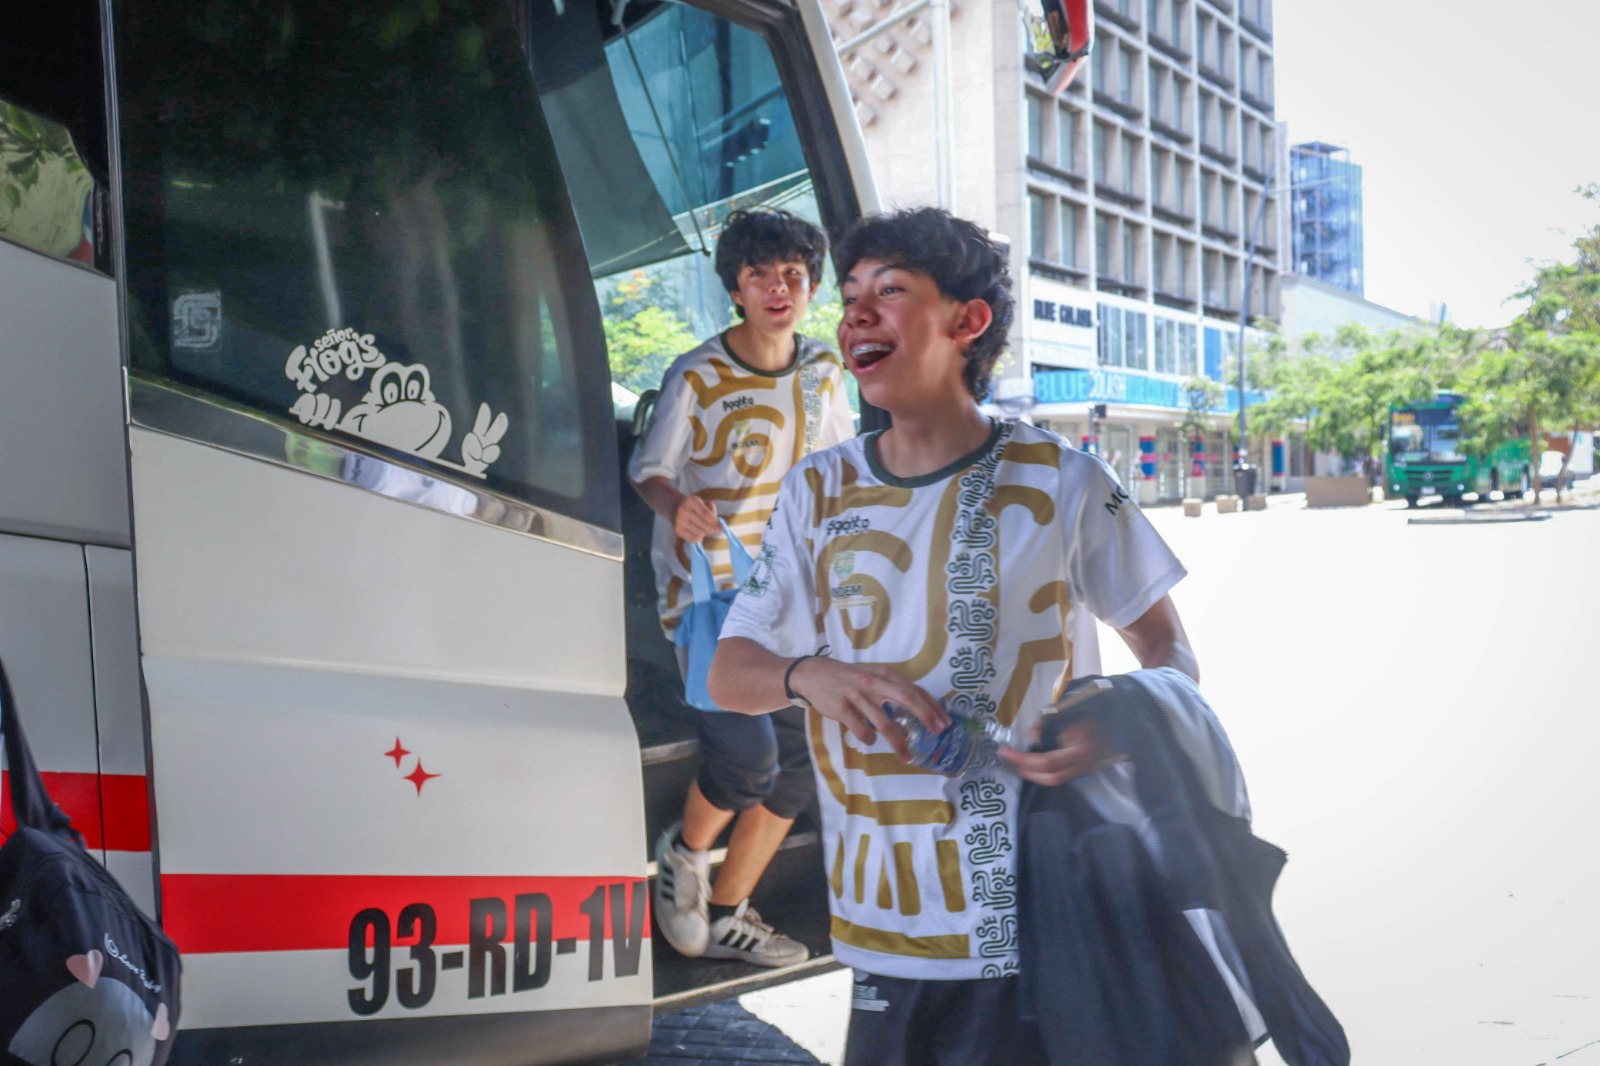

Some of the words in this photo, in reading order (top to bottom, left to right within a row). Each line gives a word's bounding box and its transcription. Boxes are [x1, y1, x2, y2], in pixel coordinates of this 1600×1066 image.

[314, 327, 354, 352] señor
[1036, 373, 1088, 401] BLUE
[347, 881, 648, 1017] 93-RD-1V
